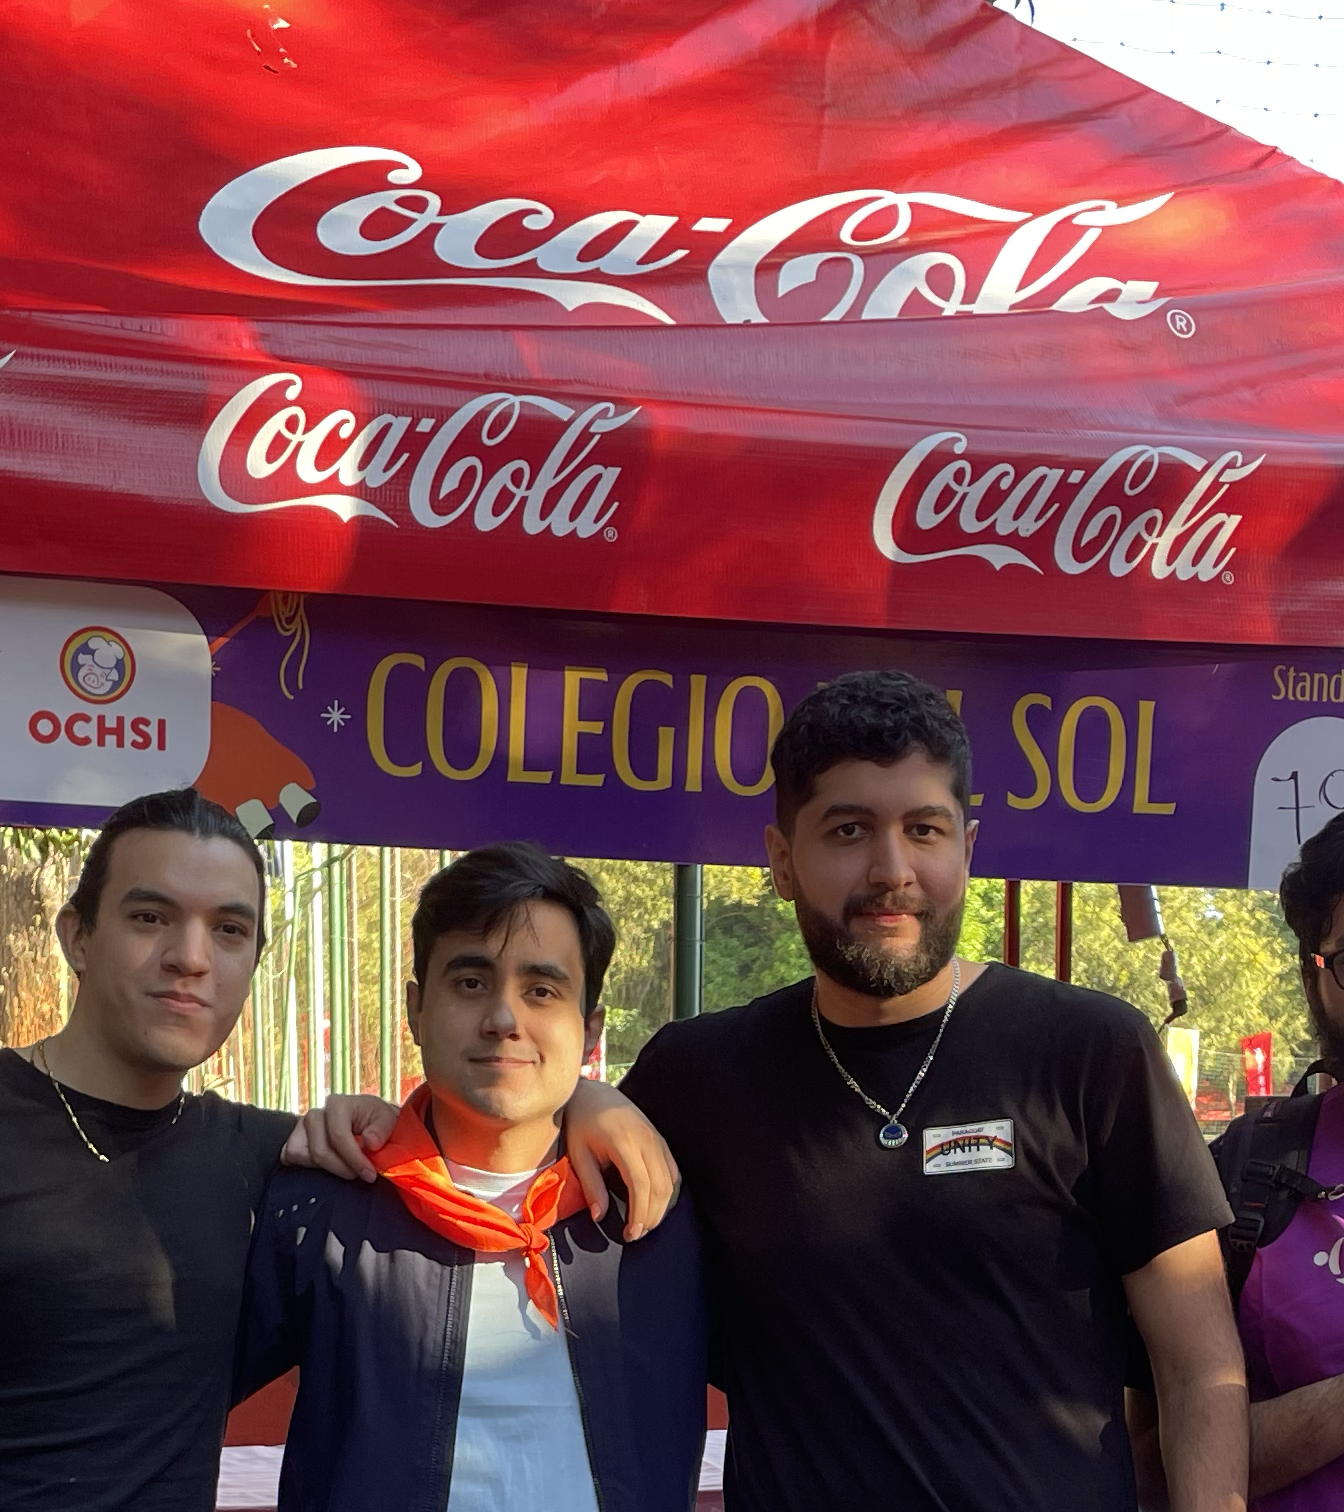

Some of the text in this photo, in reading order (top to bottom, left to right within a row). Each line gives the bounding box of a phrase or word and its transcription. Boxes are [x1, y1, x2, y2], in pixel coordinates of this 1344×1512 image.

[197, 372, 642, 540] Coca-Cola
[872, 432, 1268, 584] Coca-Cola
[28, 709, 167, 751] OCHSI
[365, 653, 784, 798] COLEGIO
[1006, 694, 1177, 815] SOL
[940, 1135, 997, 1156] UNITY
